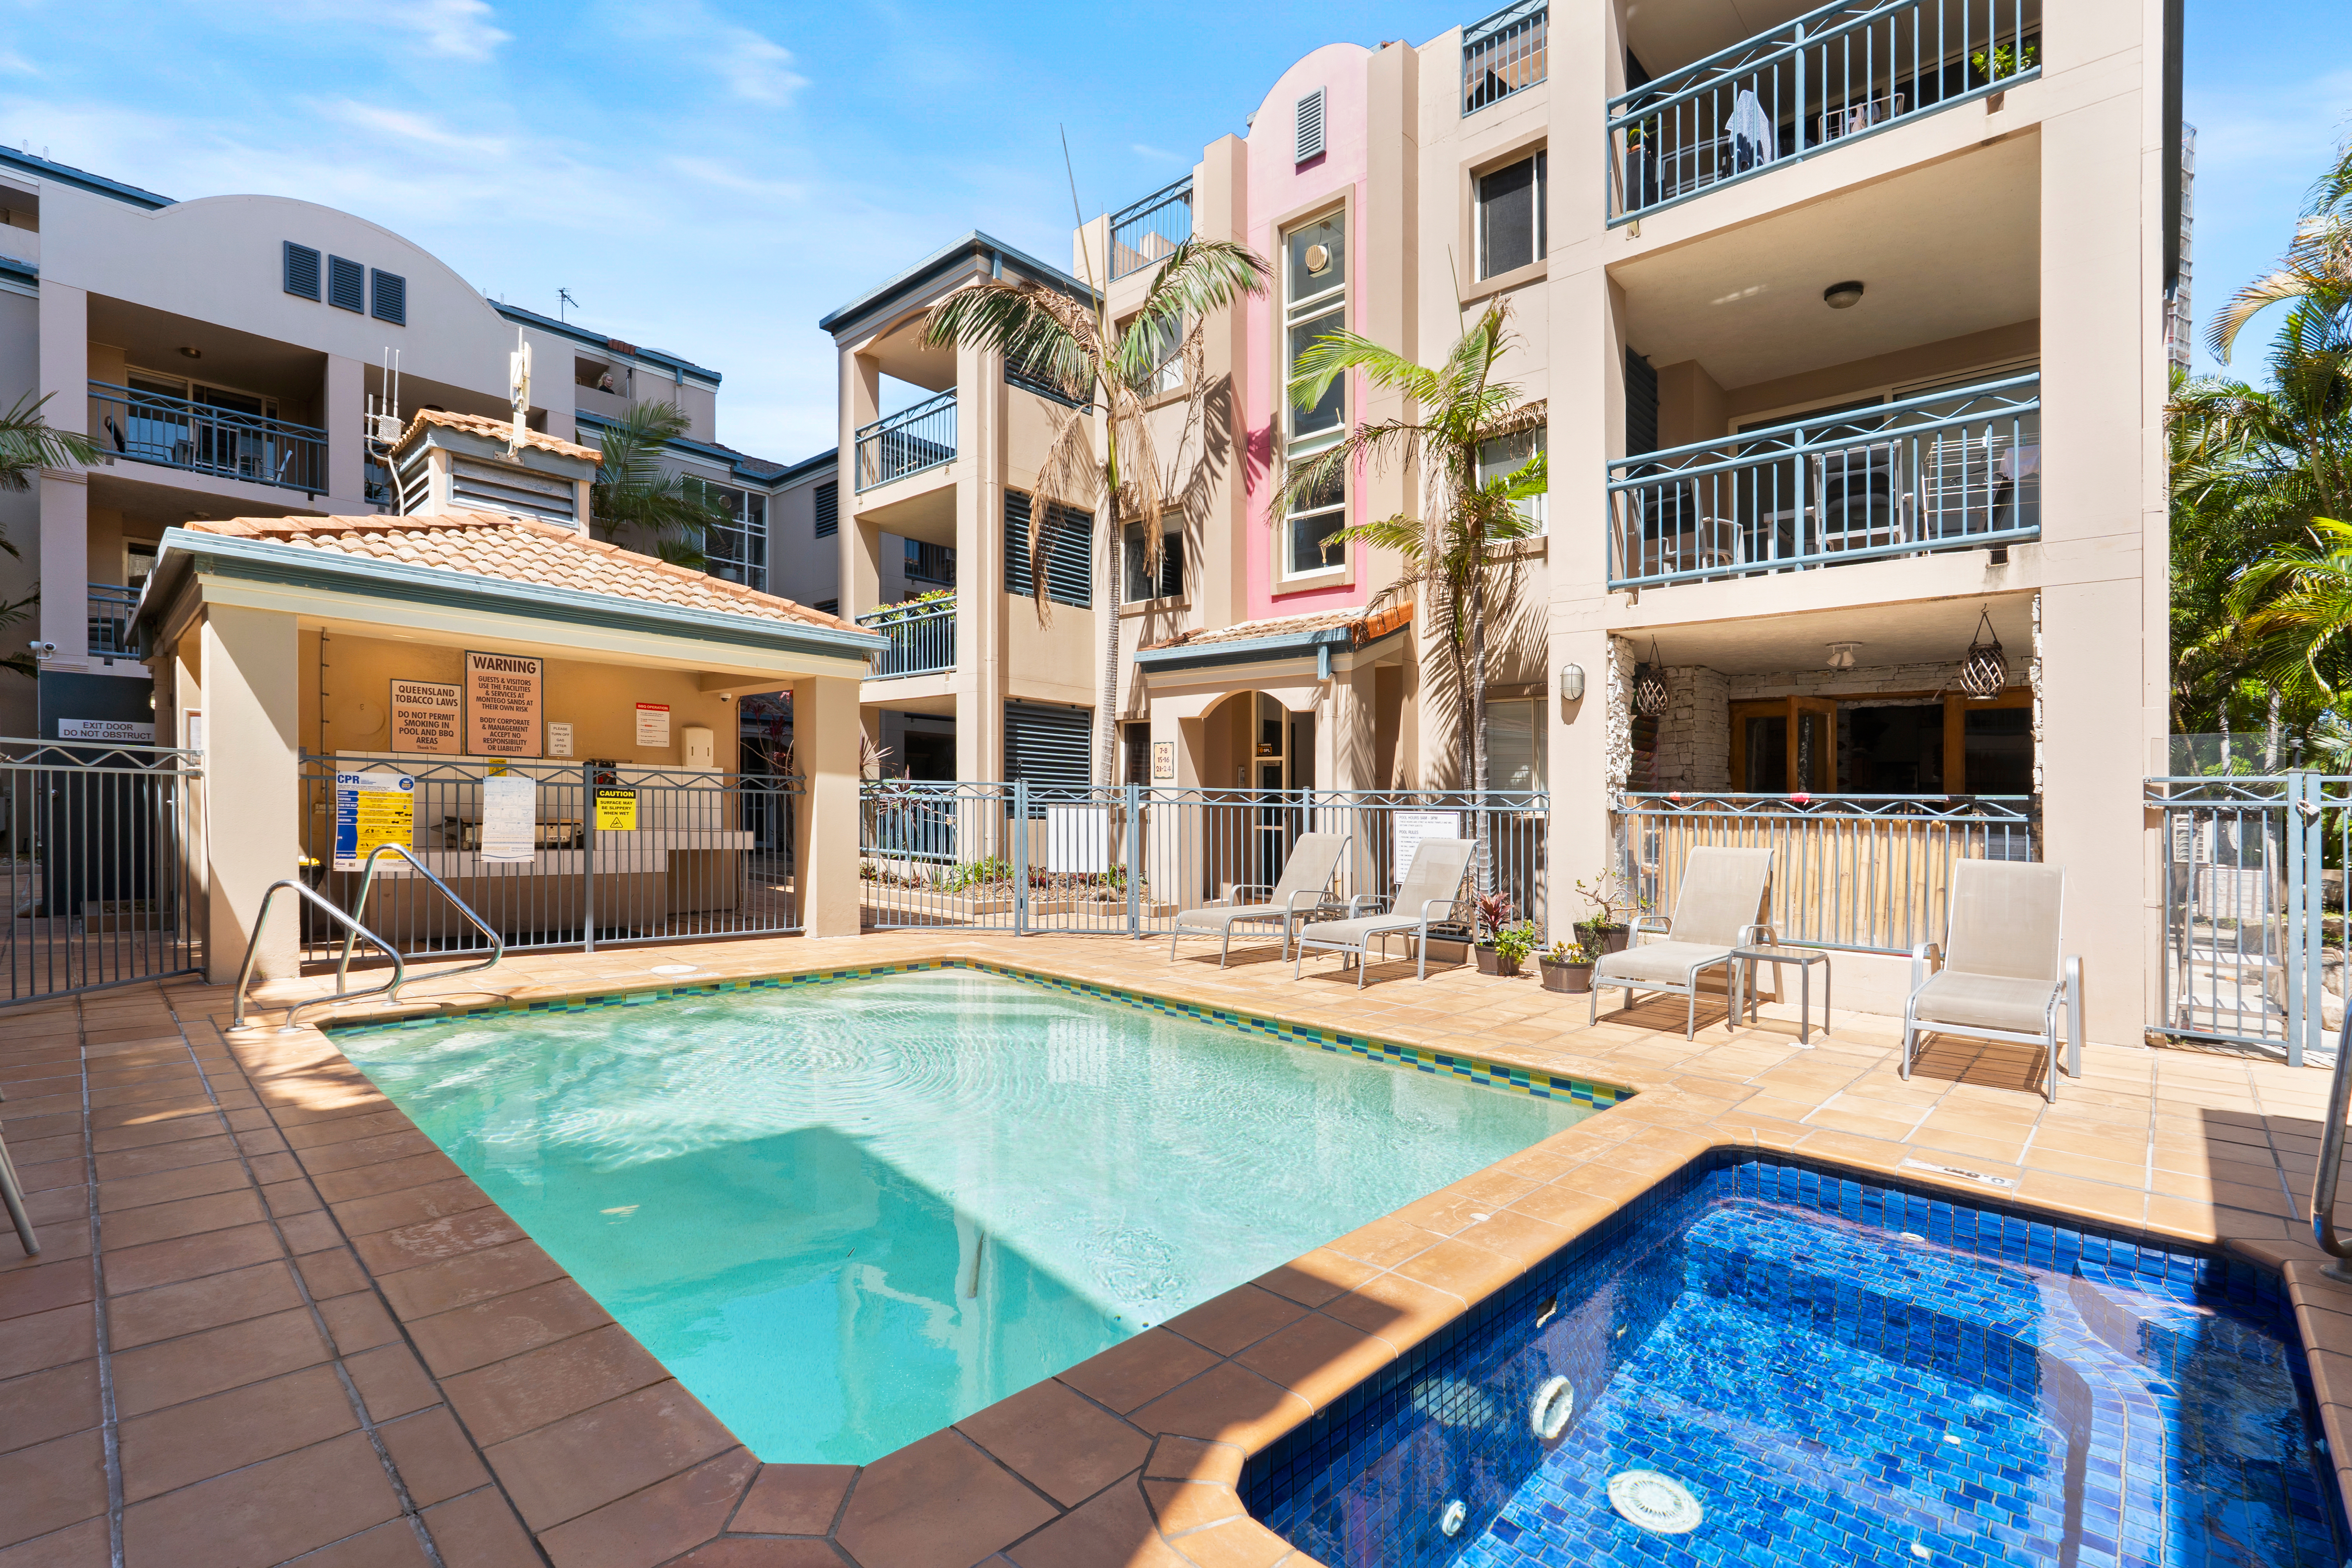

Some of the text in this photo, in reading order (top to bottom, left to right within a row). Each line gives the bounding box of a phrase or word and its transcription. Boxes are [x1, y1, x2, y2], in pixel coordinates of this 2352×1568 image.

[473, 656, 536, 673] WARNING
[399, 685, 454, 697] QUEENSLAND
[395, 695, 458, 706] TOBACCO LAWS
[405, 719, 439, 728] SMOKING
[338, 775, 359, 784] CPR
